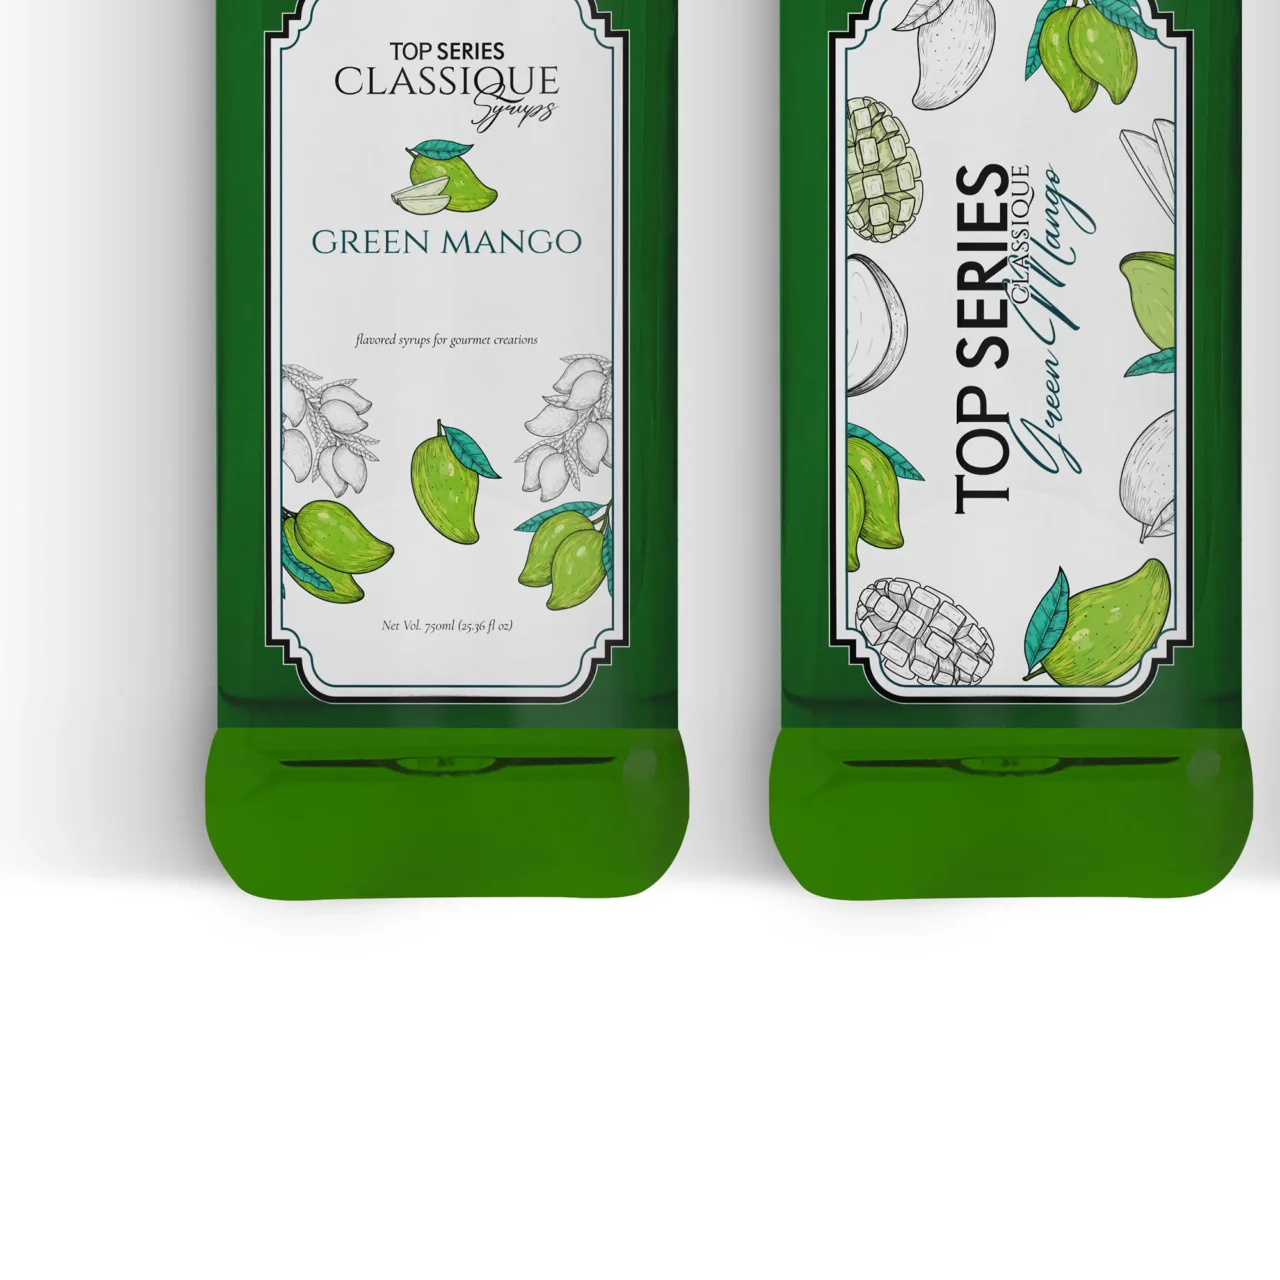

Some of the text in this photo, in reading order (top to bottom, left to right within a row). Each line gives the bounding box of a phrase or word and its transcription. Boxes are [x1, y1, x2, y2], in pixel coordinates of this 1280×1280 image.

[389, 42, 505, 61] TOP SERIES
[334, 64, 560, 103] CLASSIQUE
[470, 82, 560, 134] Syrups
[312, 229, 582, 254] GREEN MANGO
[1011, 164, 1035, 304] CLASSIQUE
[1002, 162, 1097, 475] Green Mango
[354, 333, 538, 348] flavored syrups for gourmet creations
[955, 163, 1010, 514] TOP SERIES
[382, 619, 513, 634] Net Vol. 750ml (25.36 fl oz)
